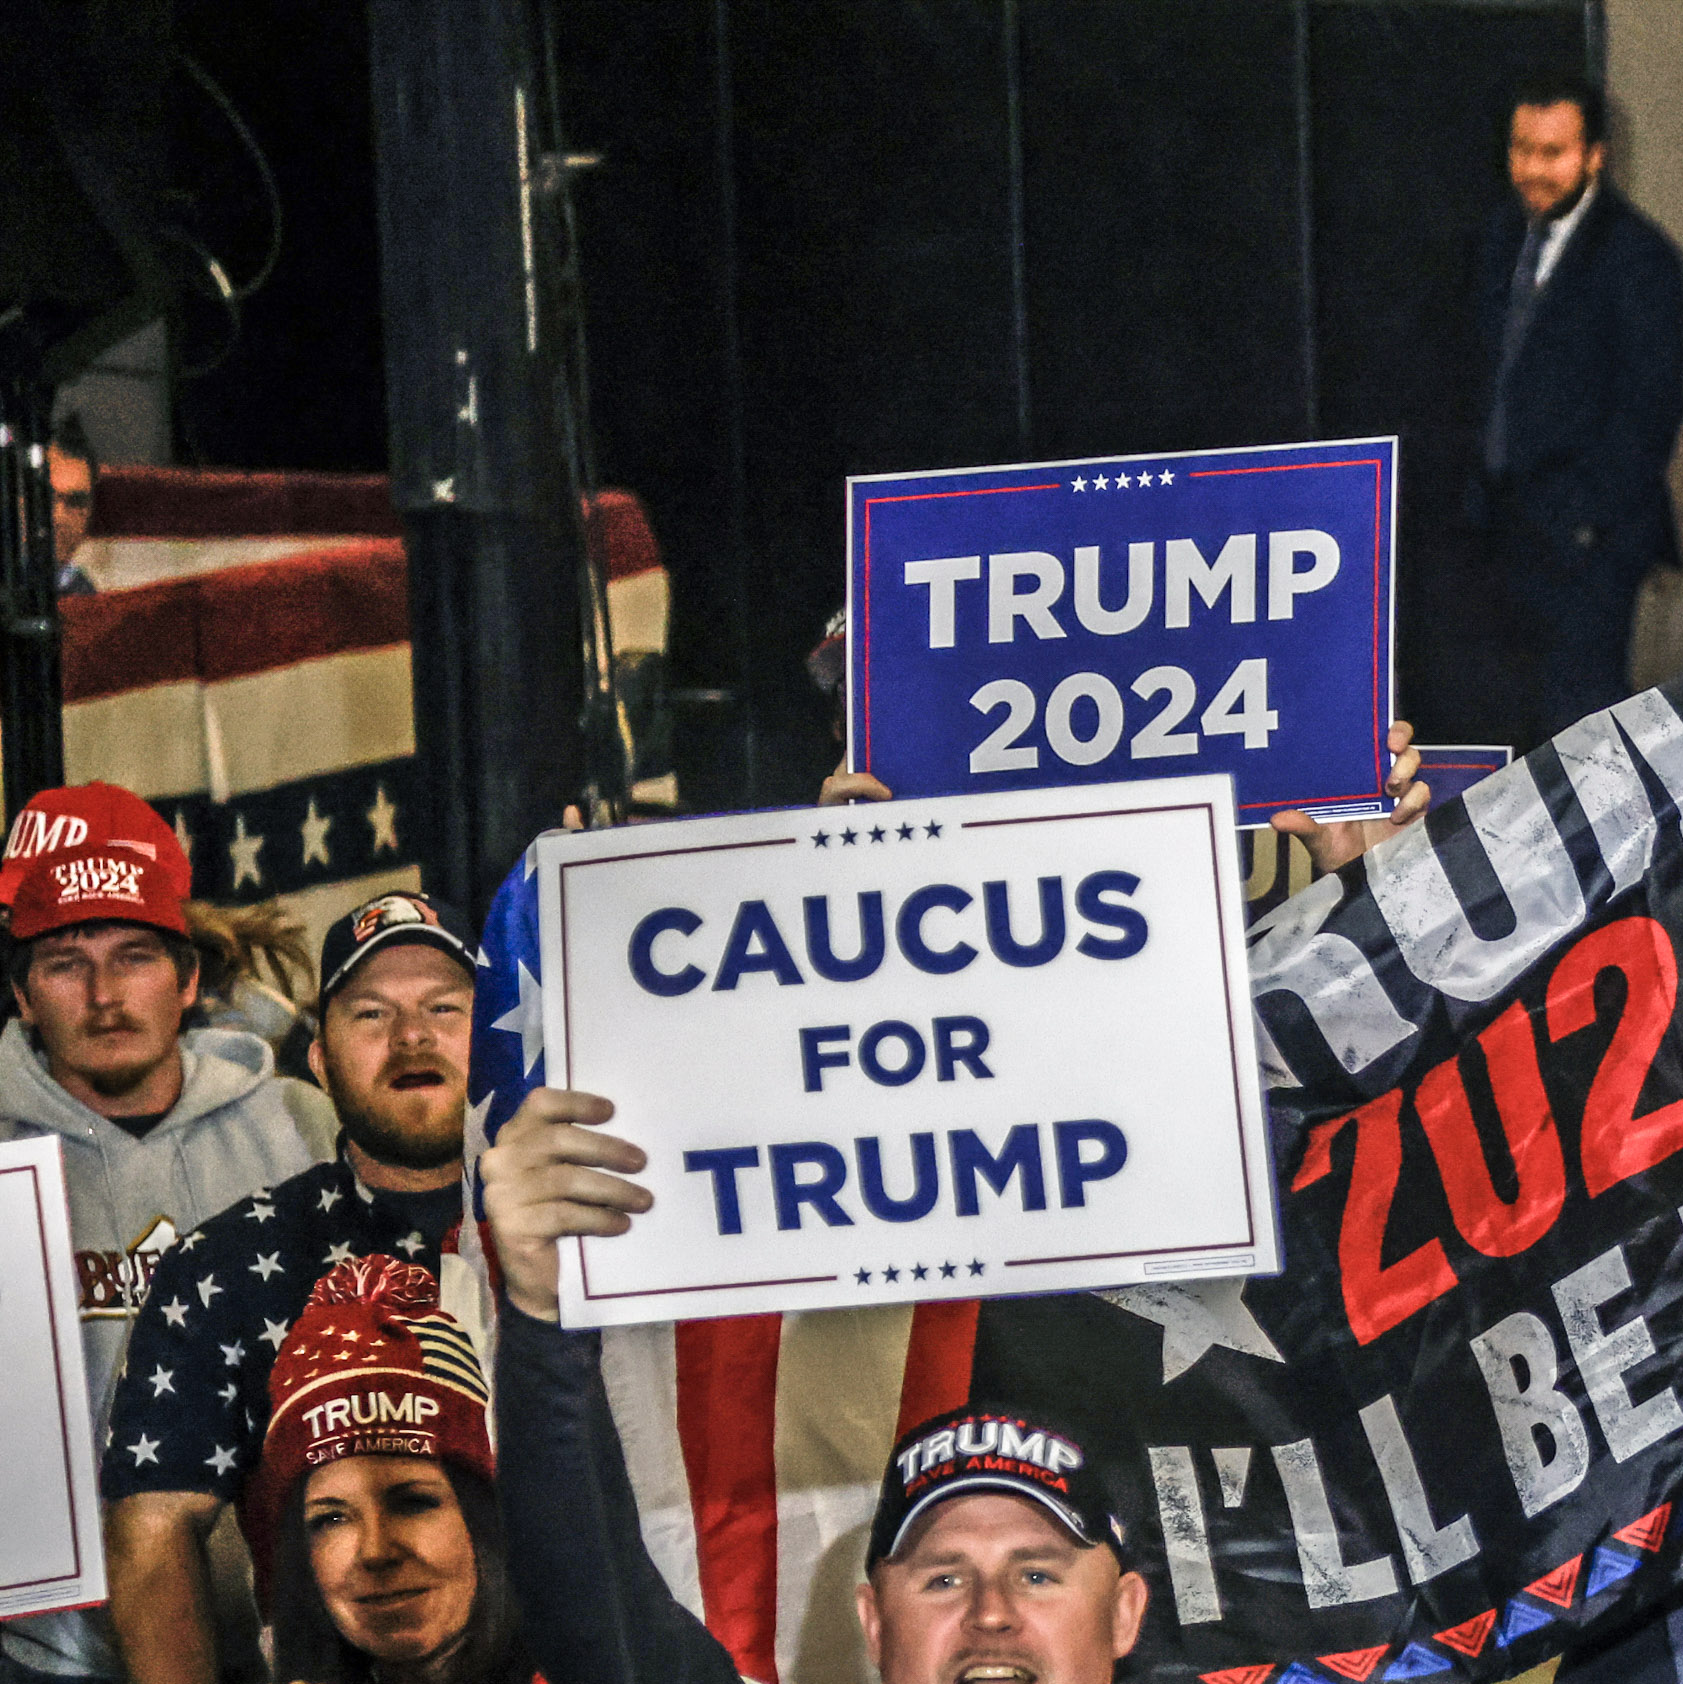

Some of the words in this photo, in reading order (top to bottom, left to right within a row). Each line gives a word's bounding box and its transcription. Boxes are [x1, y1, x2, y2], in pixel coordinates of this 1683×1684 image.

[904, 530, 1341, 650] TRUMP
[968, 659, 1278, 773] 2024
[52, 857, 144, 881] TRUMP
[60, 871, 140, 897] 2024
[627, 870, 1149, 998] CAUCUS
[799, 1016, 995, 1092] FOR
[684, 1119, 1128, 1235] TRUMP
[302, 1391, 440, 1438] TRUMP
[354, 1438, 433, 1454] AMERICA
[897, 1421, 1083, 1485] TRUMP
[966, 1456, 1070, 1493] AMERICA
[1147, 1395, 1480, 1626] I'LL
